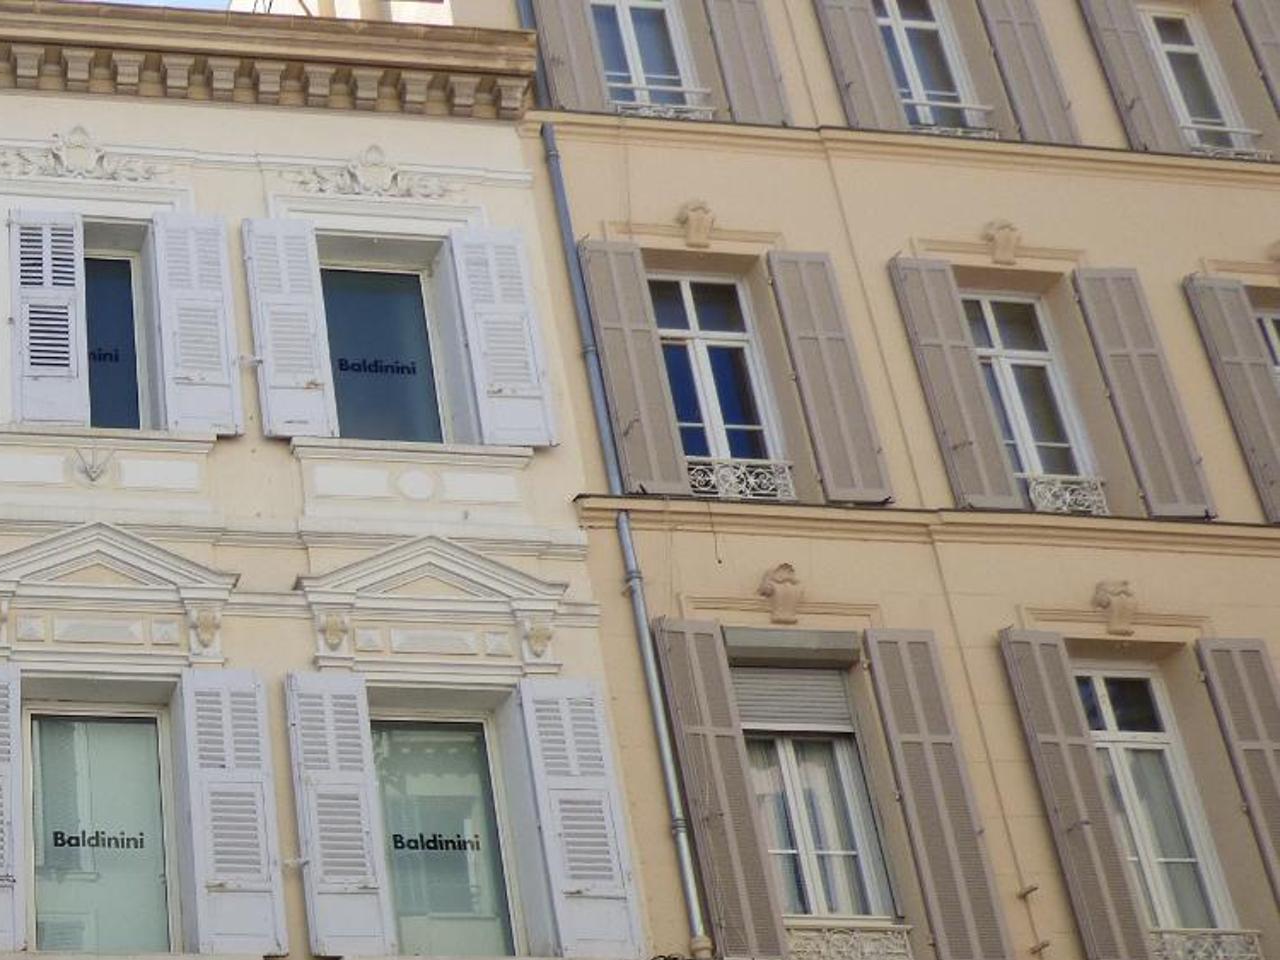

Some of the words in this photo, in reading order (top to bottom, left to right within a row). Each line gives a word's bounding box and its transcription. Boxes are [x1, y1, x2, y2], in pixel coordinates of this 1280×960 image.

[337, 356, 417, 376] Baldinini
[53, 830, 145, 849] Baldinini
[392, 833, 481, 851] Baldinini
